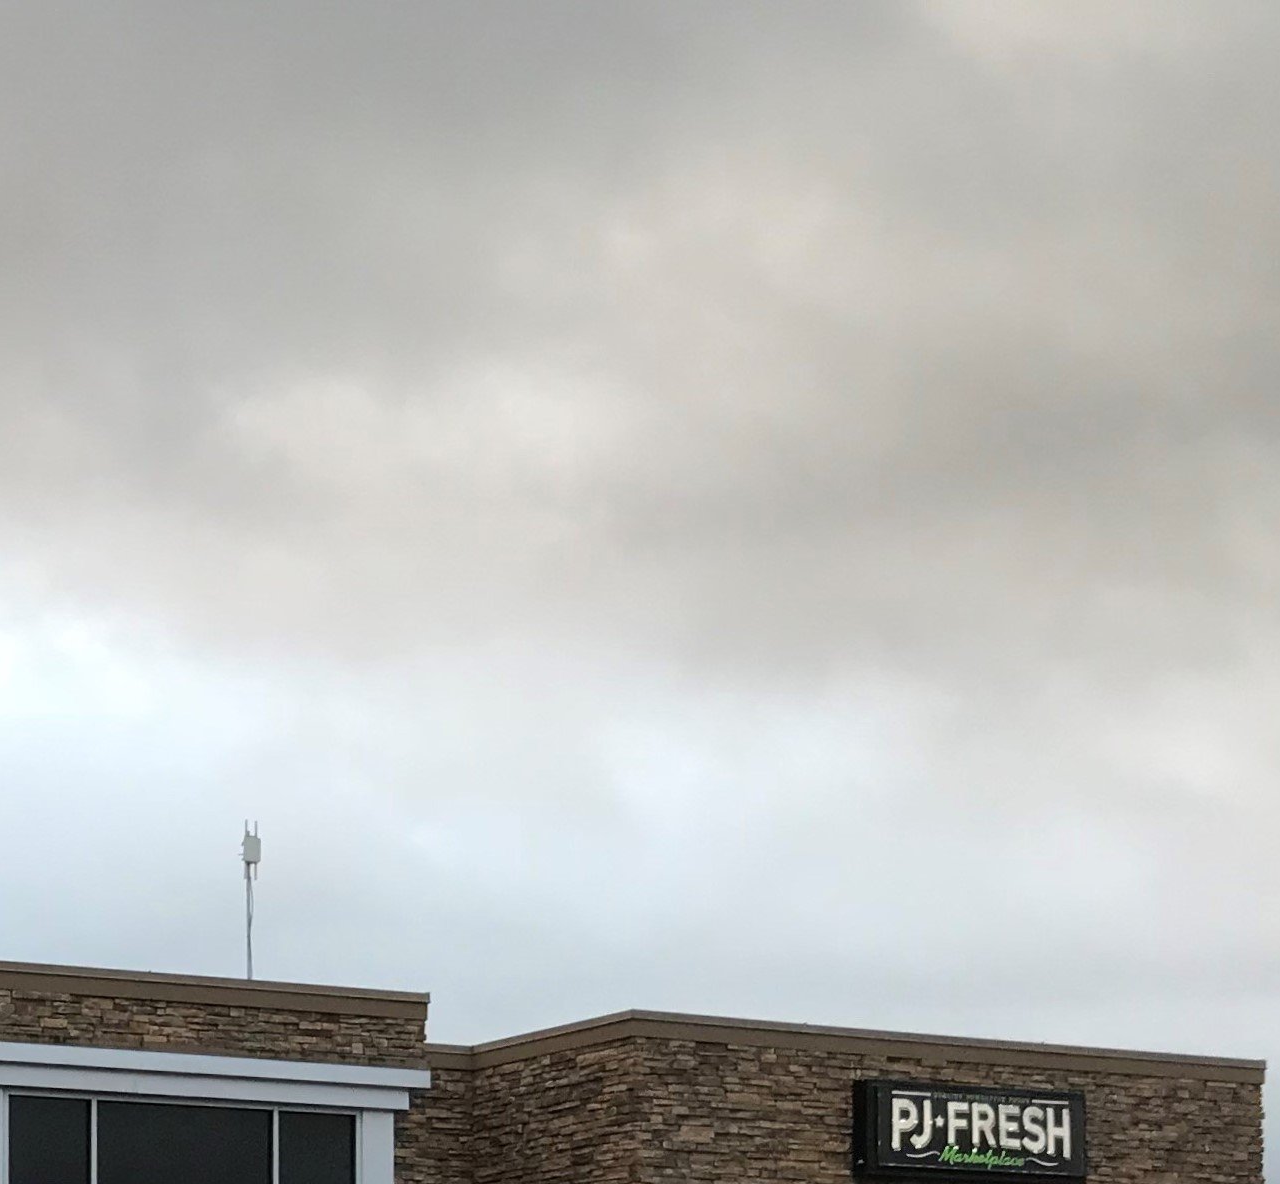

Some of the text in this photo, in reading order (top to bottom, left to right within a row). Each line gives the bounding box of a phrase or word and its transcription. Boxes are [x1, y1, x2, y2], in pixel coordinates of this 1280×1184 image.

[891, 1098, 1072, 1160] PJ FRESH
[938, 1145, 1025, 1169] Marketplace
